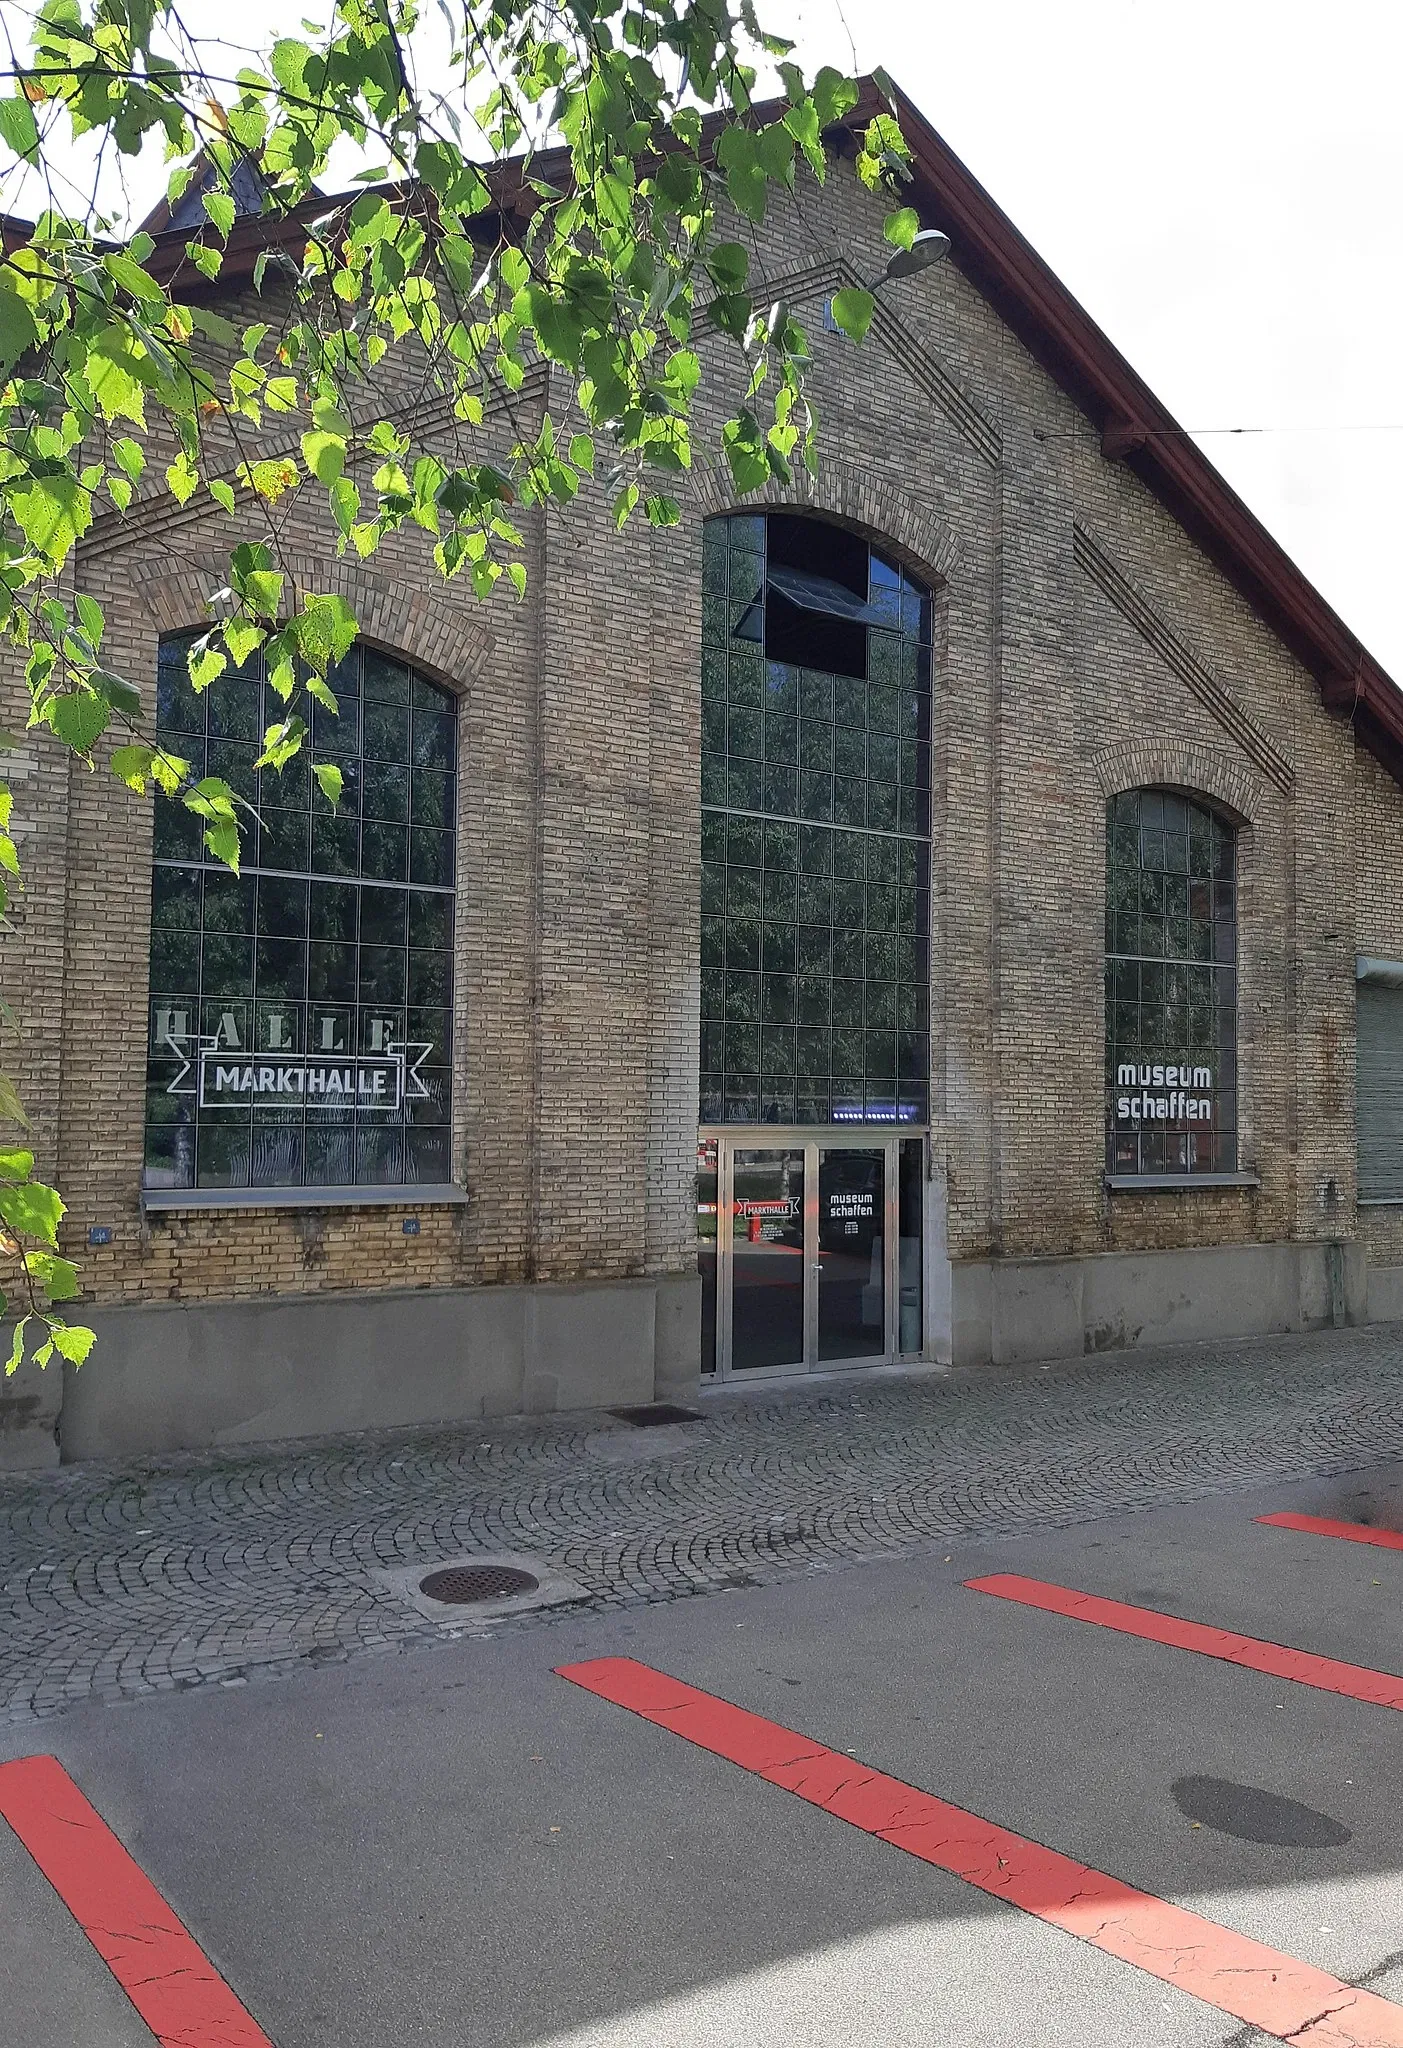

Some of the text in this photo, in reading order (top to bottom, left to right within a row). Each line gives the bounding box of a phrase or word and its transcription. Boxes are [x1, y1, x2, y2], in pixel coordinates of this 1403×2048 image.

[216, 1066, 387, 1094] MARKTHALLE
[1117, 1064, 1211, 1088] museum
[1117, 1090, 1211, 1119] schaffen
[830, 1194, 873, 1204] museum
[747, 1205, 790, 1215] MARKTHALLE
[830, 1204, 873, 1217] schaffen
